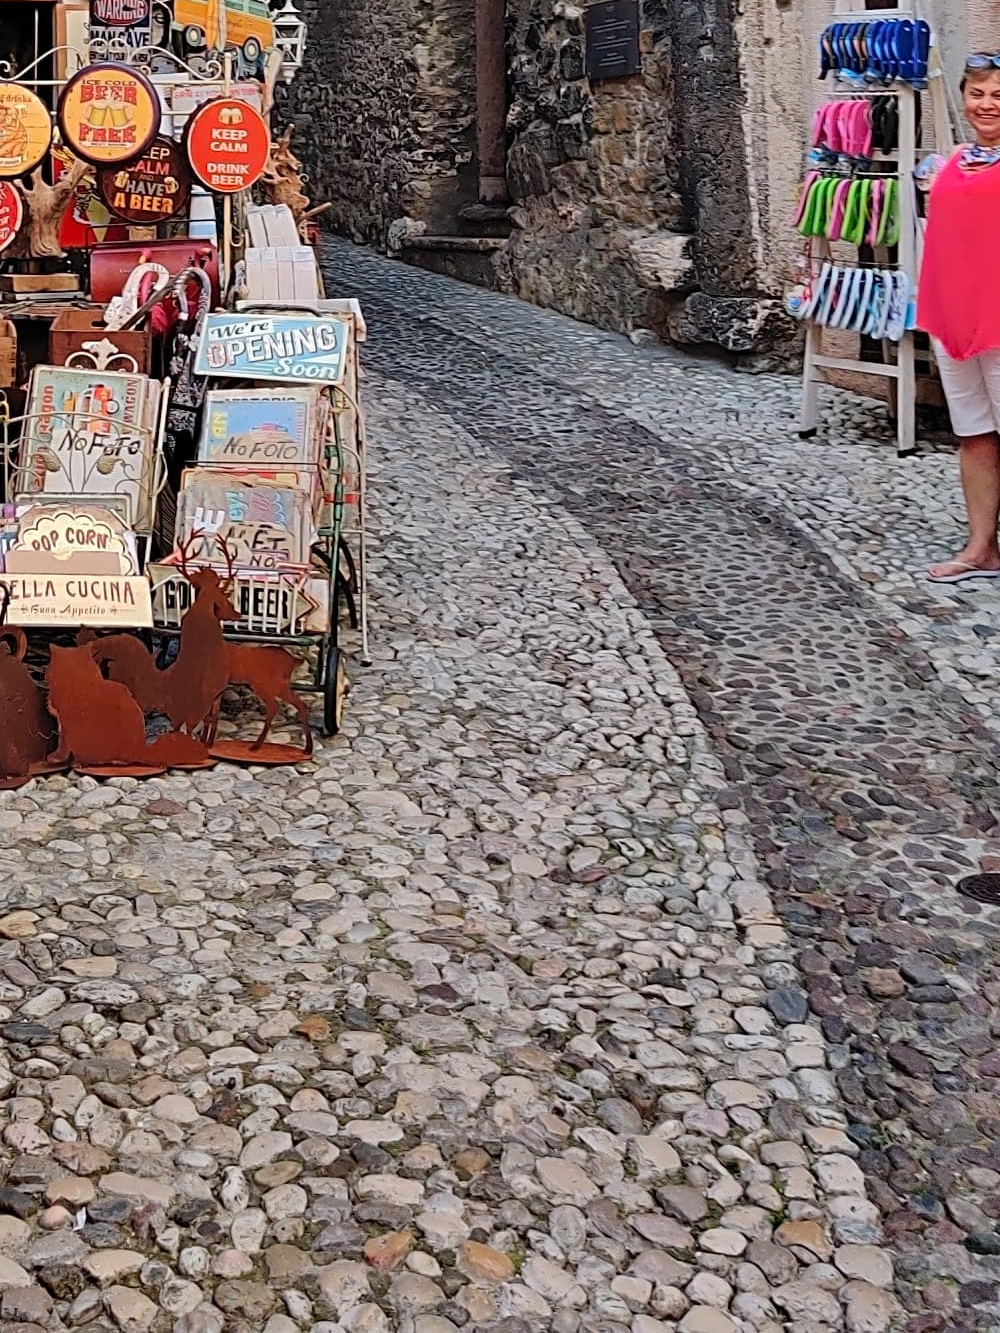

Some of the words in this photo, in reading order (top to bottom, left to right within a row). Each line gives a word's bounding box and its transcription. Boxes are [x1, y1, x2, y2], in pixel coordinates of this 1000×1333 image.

[117, 29, 150, 48] CAVE
[80, 84, 138, 107] BEER
[79, 121, 137, 144] FREE
[211, 128, 248, 141] KEEP
[210, 141, 248, 153] CALM
[206, 162, 250, 175] DRINK
[125, 179, 165, 197] HAVE
[211, 174, 244, 186] BEER
[113, 192, 126, 208] A
[129, 193, 174, 214] BEER
[210, 321, 270, 339] We're
[207, 324, 337, 368] OPENING
[273, 357, 336, 379] Soon
[31, 529, 60, 551] POP
[65, 527, 109, 550] CORN
[65, 580, 136, 606] CUCINA
[240, 585, 288, 619] BEER
